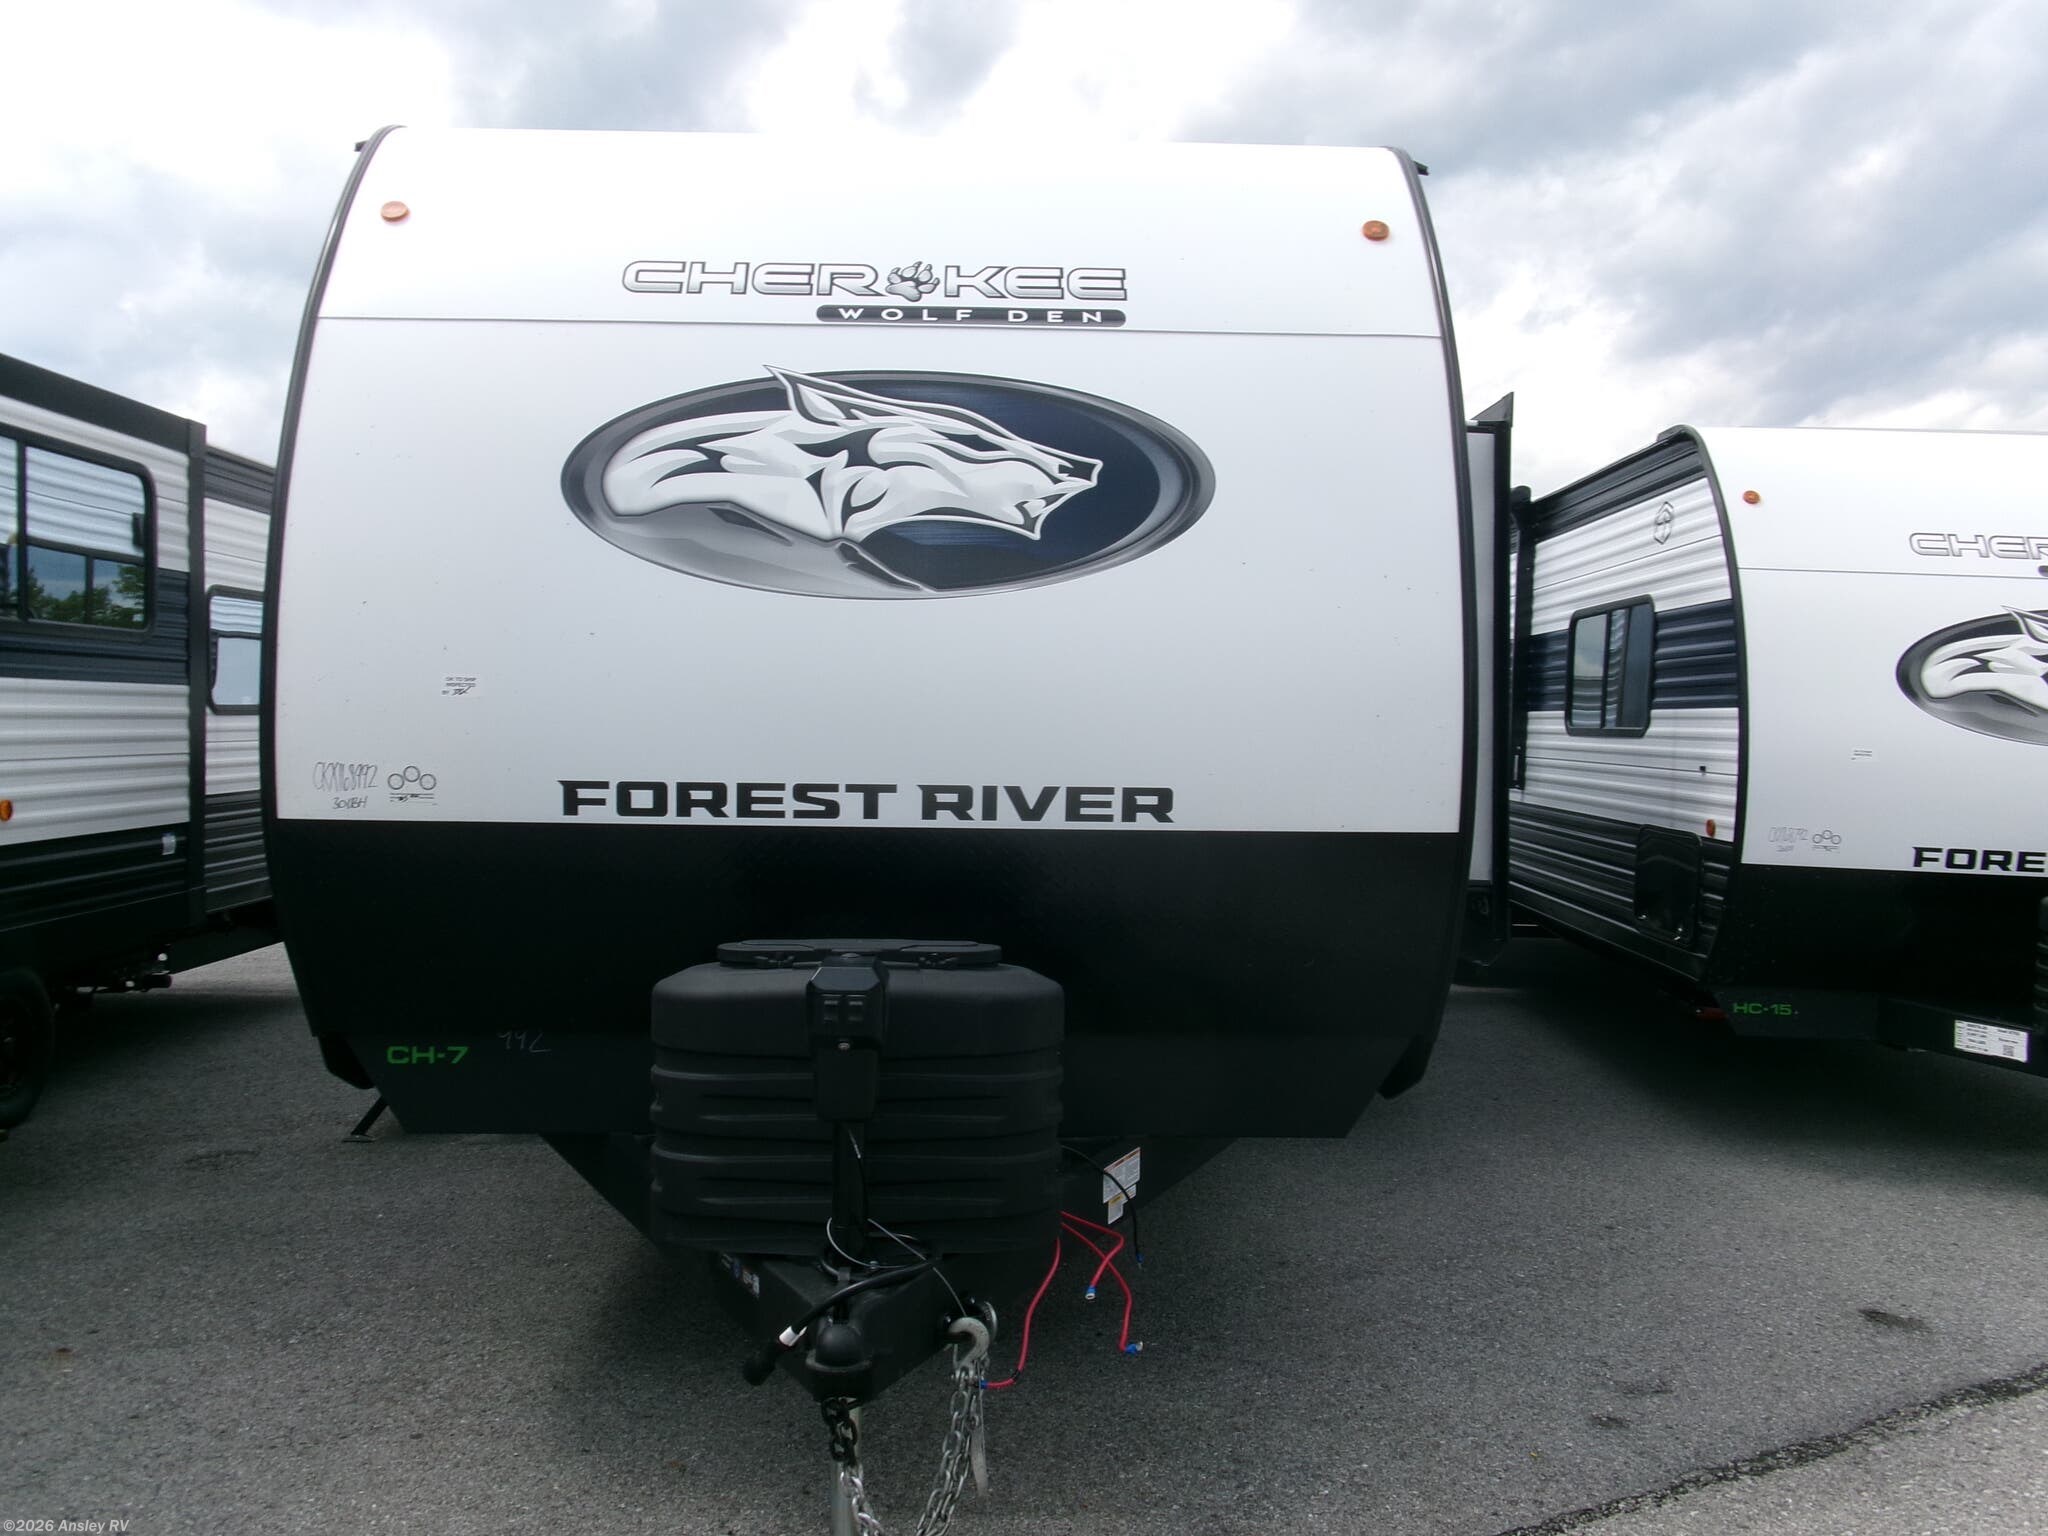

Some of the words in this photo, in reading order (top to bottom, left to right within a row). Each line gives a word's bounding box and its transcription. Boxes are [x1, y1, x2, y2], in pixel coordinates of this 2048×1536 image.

[838, 308, 973, 322] WOLF
[1007, 310, 1103, 323] DEN
[557, 780, 897, 820] FOREST
[916, 784, 1174, 824] RIVER
[386, 1045, 469, 1064] CH-7
